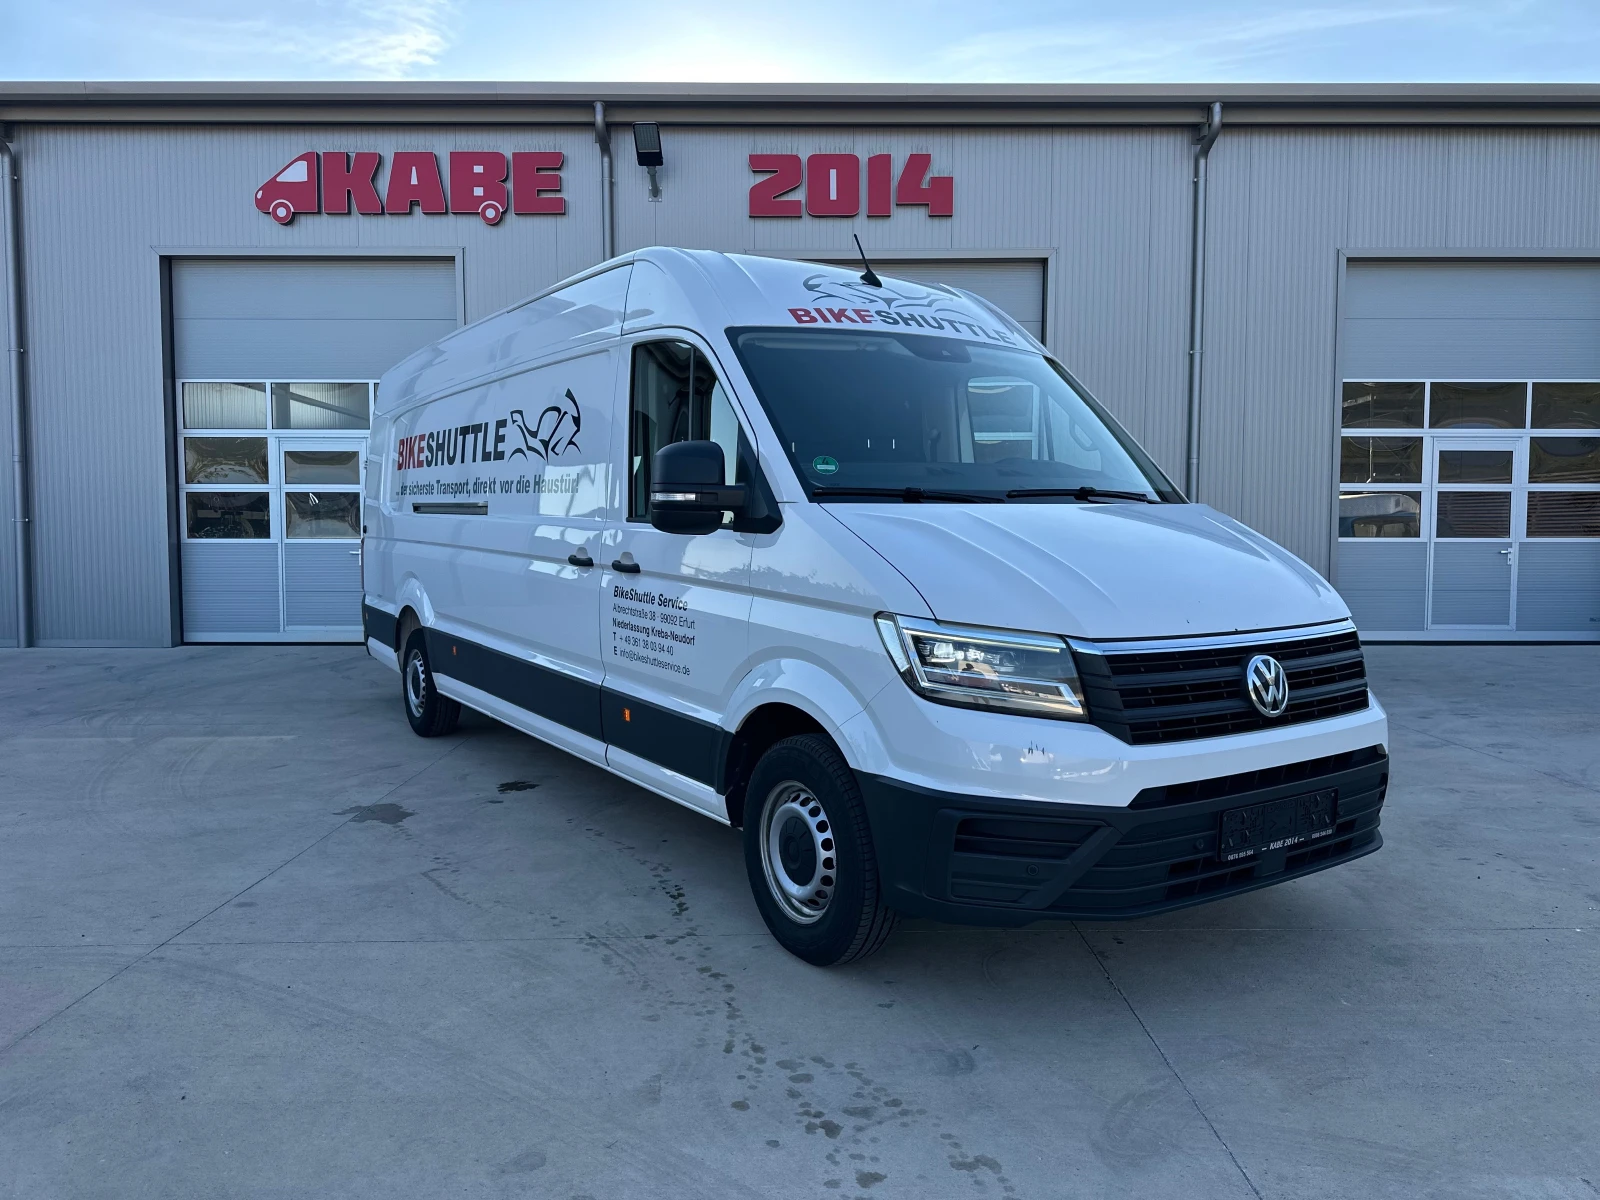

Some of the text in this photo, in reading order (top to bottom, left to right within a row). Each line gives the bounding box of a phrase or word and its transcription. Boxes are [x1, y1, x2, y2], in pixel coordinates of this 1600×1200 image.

[321, 151, 954, 227] KABE 2014
[788, 307, 1018, 346] BIKESHUTTLE
[397, 418, 508, 471] BIKESHUTTLE
[400, 482, 408, 496] der
[408, 480, 435, 496] sicherste
[436, 479, 471, 499] Transport,
[472, 476, 497, 495] direkt
[500, 479, 514, 494] vor
[515, 475, 531, 494] die
[533, 472, 580, 494] Haustür!
[613, 585, 689, 611] BikeShuttle Service
[612, 603, 649, 620] Albrechtstraße
[678, 616, 696, 630] Erfurt
[612, 617, 650, 637] Niederlassung
[612, 631, 617, 642] T
[666, 645, 674, 656] 40
[613, 645, 618, 656] E
